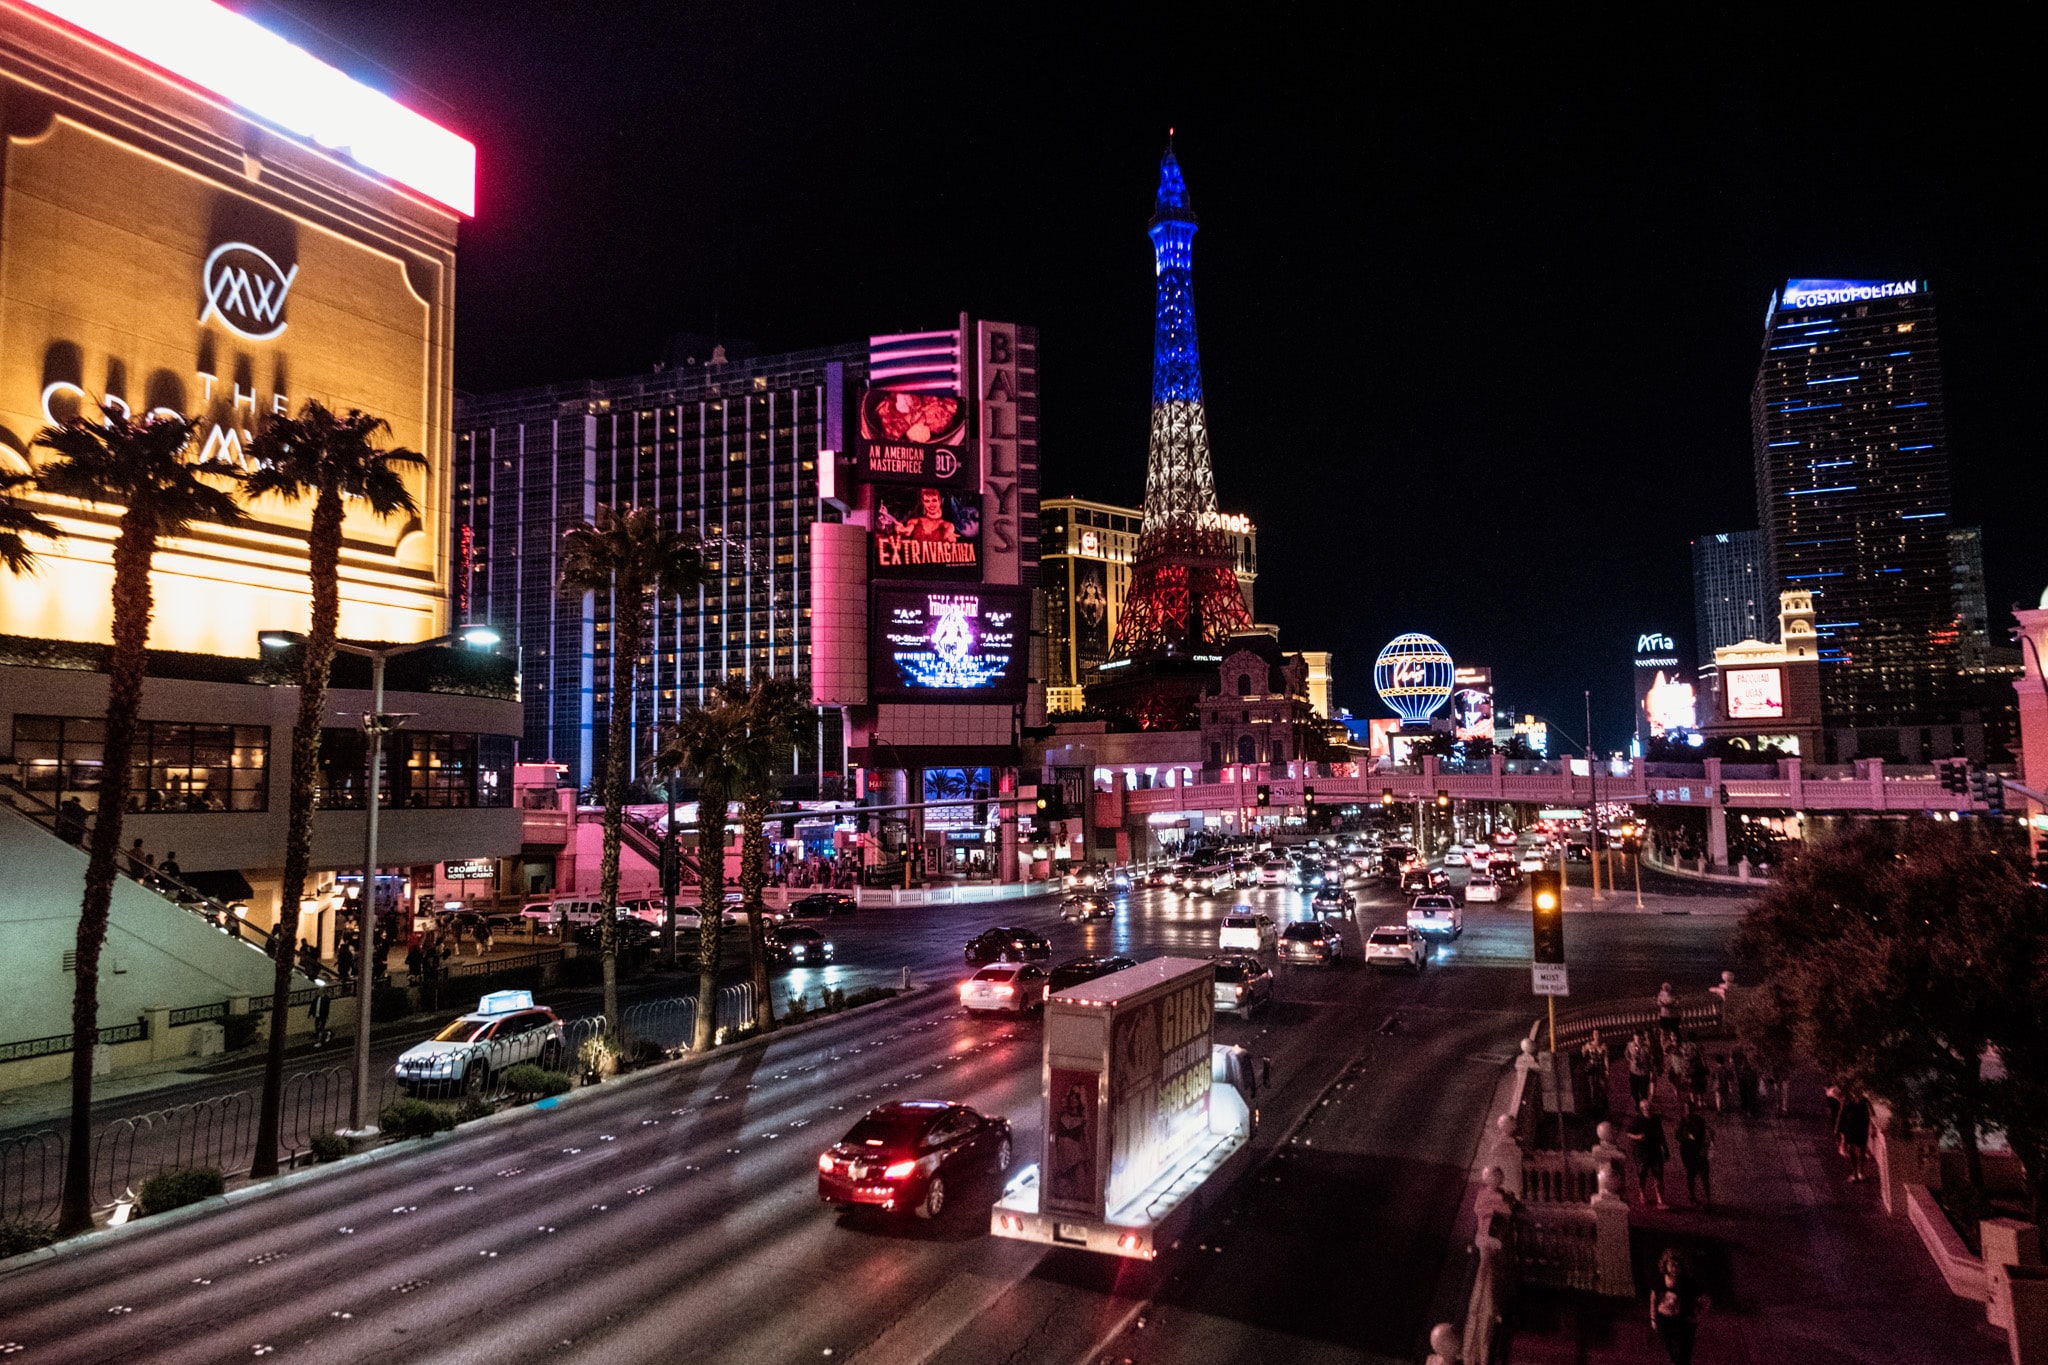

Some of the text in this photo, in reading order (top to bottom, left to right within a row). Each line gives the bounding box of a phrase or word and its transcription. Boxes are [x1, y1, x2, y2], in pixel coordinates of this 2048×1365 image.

[1796, 279, 1917, 309] COSMOPOLITAN
[197, 371, 289, 414] THE
[869, 445, 924, 460] AN AMERICAN
[870, 458, 923, 474] MASTERPIECE
[936, 455, 951, 472] BLT
[879, 536, 976, 566] EXTRAVAGANZA
[1638, 633, 1674, 652] Aria
[1514, 722, 1547, 734] MGM
[447, 865, 494, 873] CROMWELL
[1540, 973, 1559, 981] MUST
[1161, 979, 1211, 1054] GIRLS
